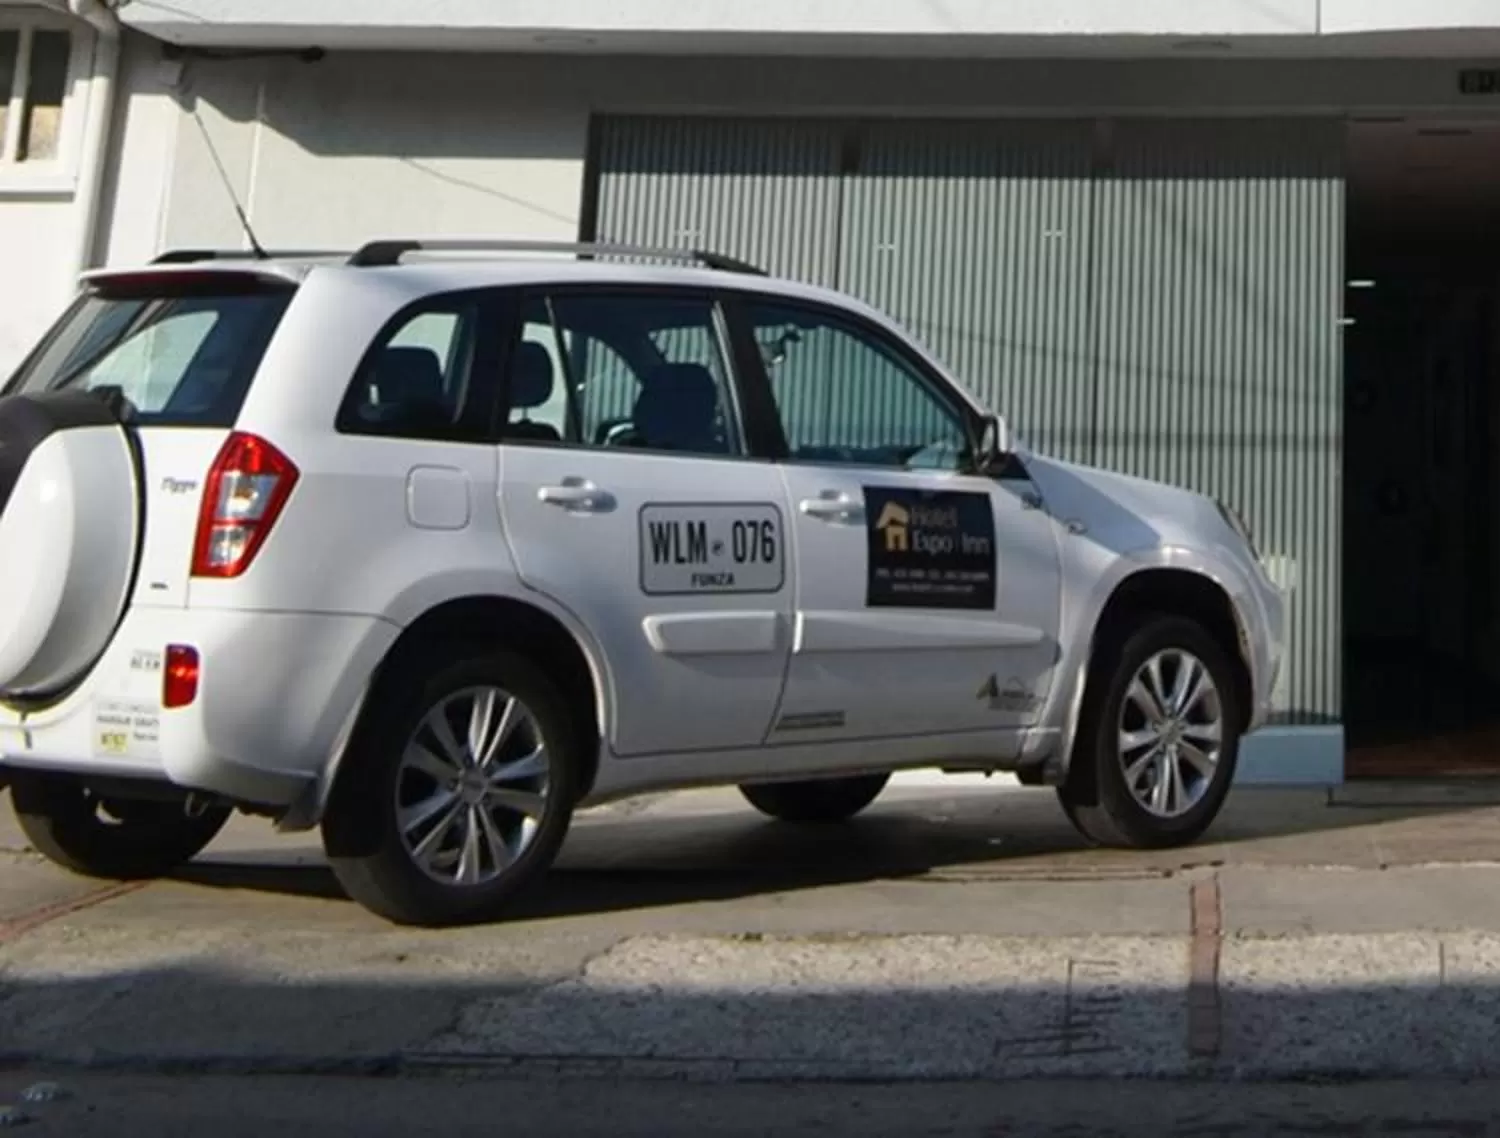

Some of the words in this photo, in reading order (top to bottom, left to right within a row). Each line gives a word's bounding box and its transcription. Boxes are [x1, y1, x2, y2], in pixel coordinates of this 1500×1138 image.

[911, 505, 957, 527] Hotel
[648, 520, 708, 564] WLM
[732, 519, 776, 564] 076
[911, 529, 954, 556] Expo
[961, 531, 991, 556] Inn
[690, 571, 736, 587] FUNZA
